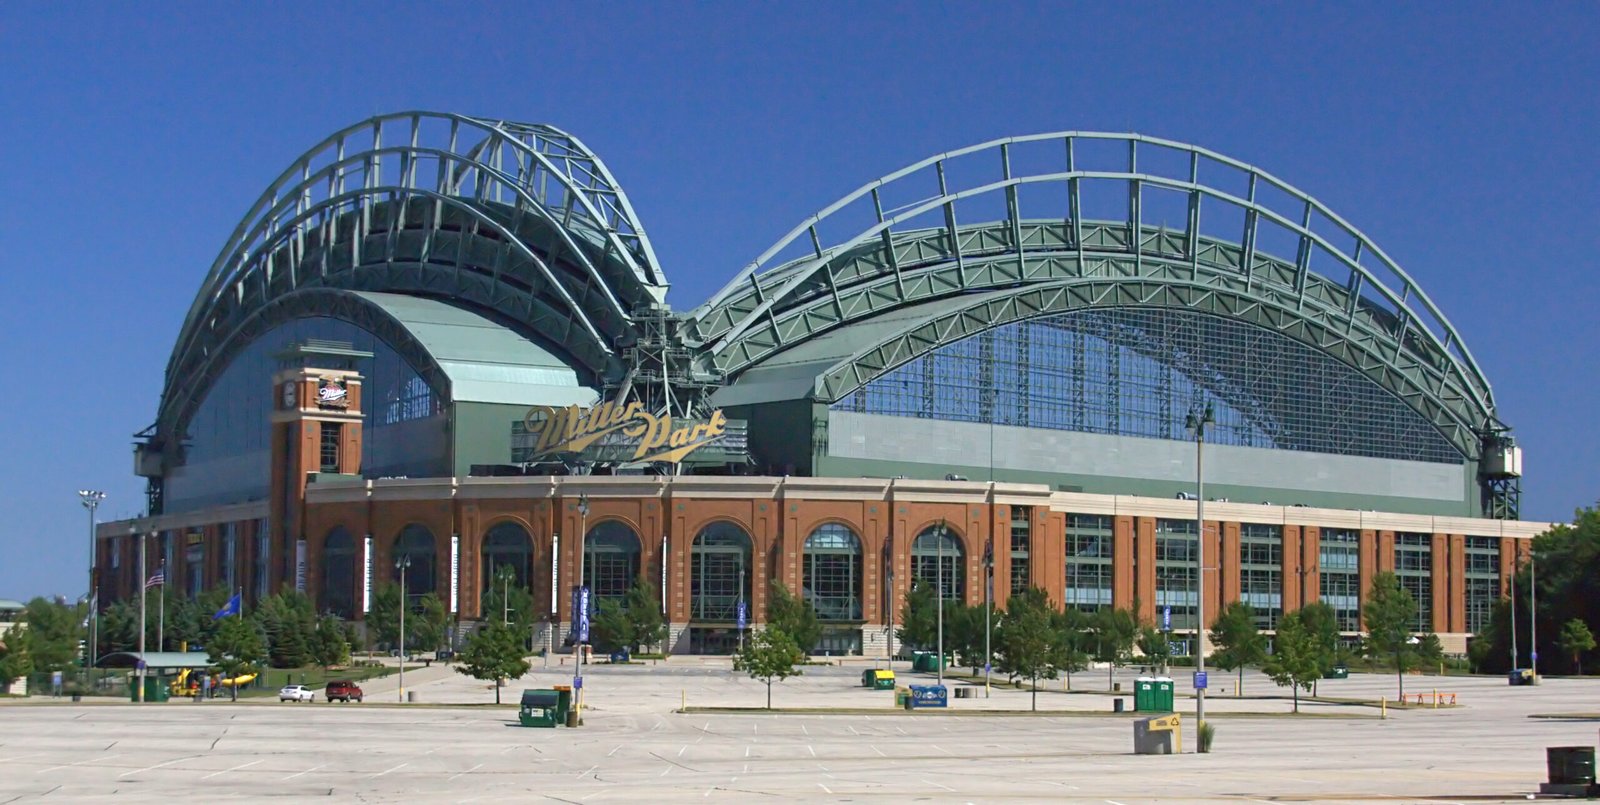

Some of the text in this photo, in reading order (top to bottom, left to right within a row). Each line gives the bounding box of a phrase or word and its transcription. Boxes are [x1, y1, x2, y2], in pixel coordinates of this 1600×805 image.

[320, 388, 347, 401] Miller
[524, 400, 727, 461] Miller Park
[298, 561, 306, 590] BRAUN
